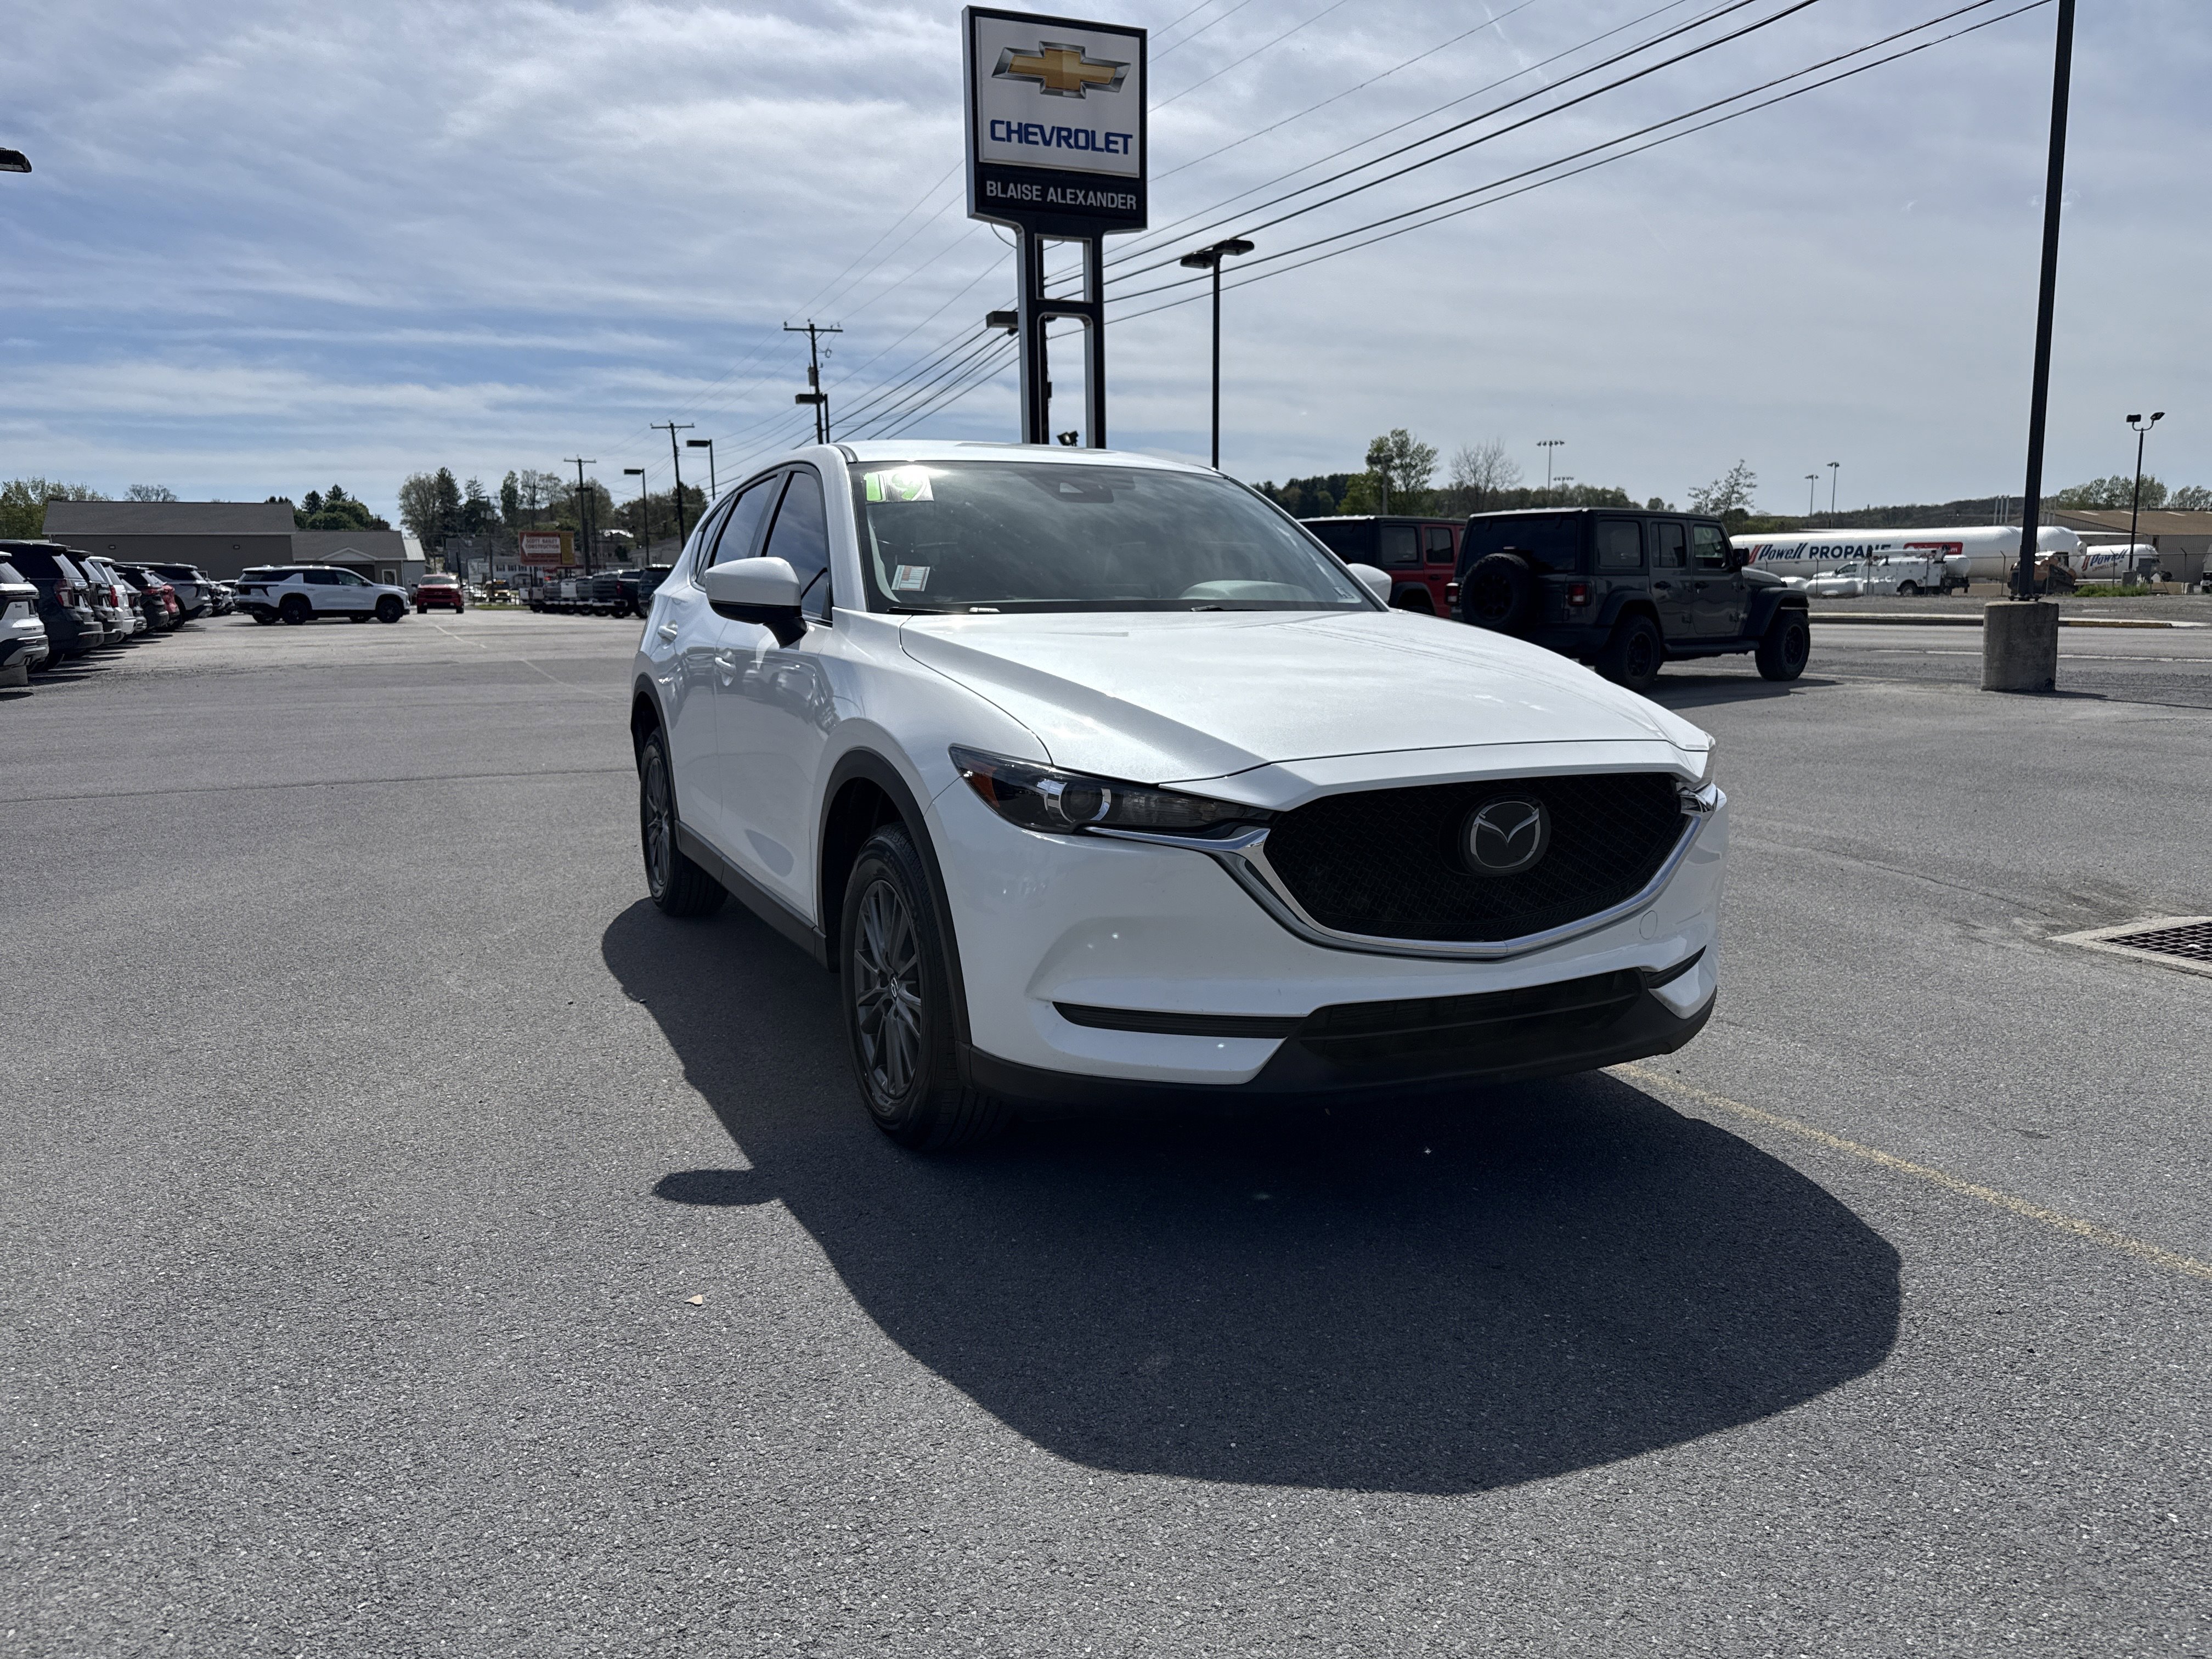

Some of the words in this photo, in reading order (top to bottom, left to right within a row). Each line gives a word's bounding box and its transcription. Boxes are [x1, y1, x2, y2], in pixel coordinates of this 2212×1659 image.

[990, 119, 1133, 155] CHEVROLET
[986, 180, 1042, 201] BLAISE
[1046, 187, 1137, 210] ALEXANDER
